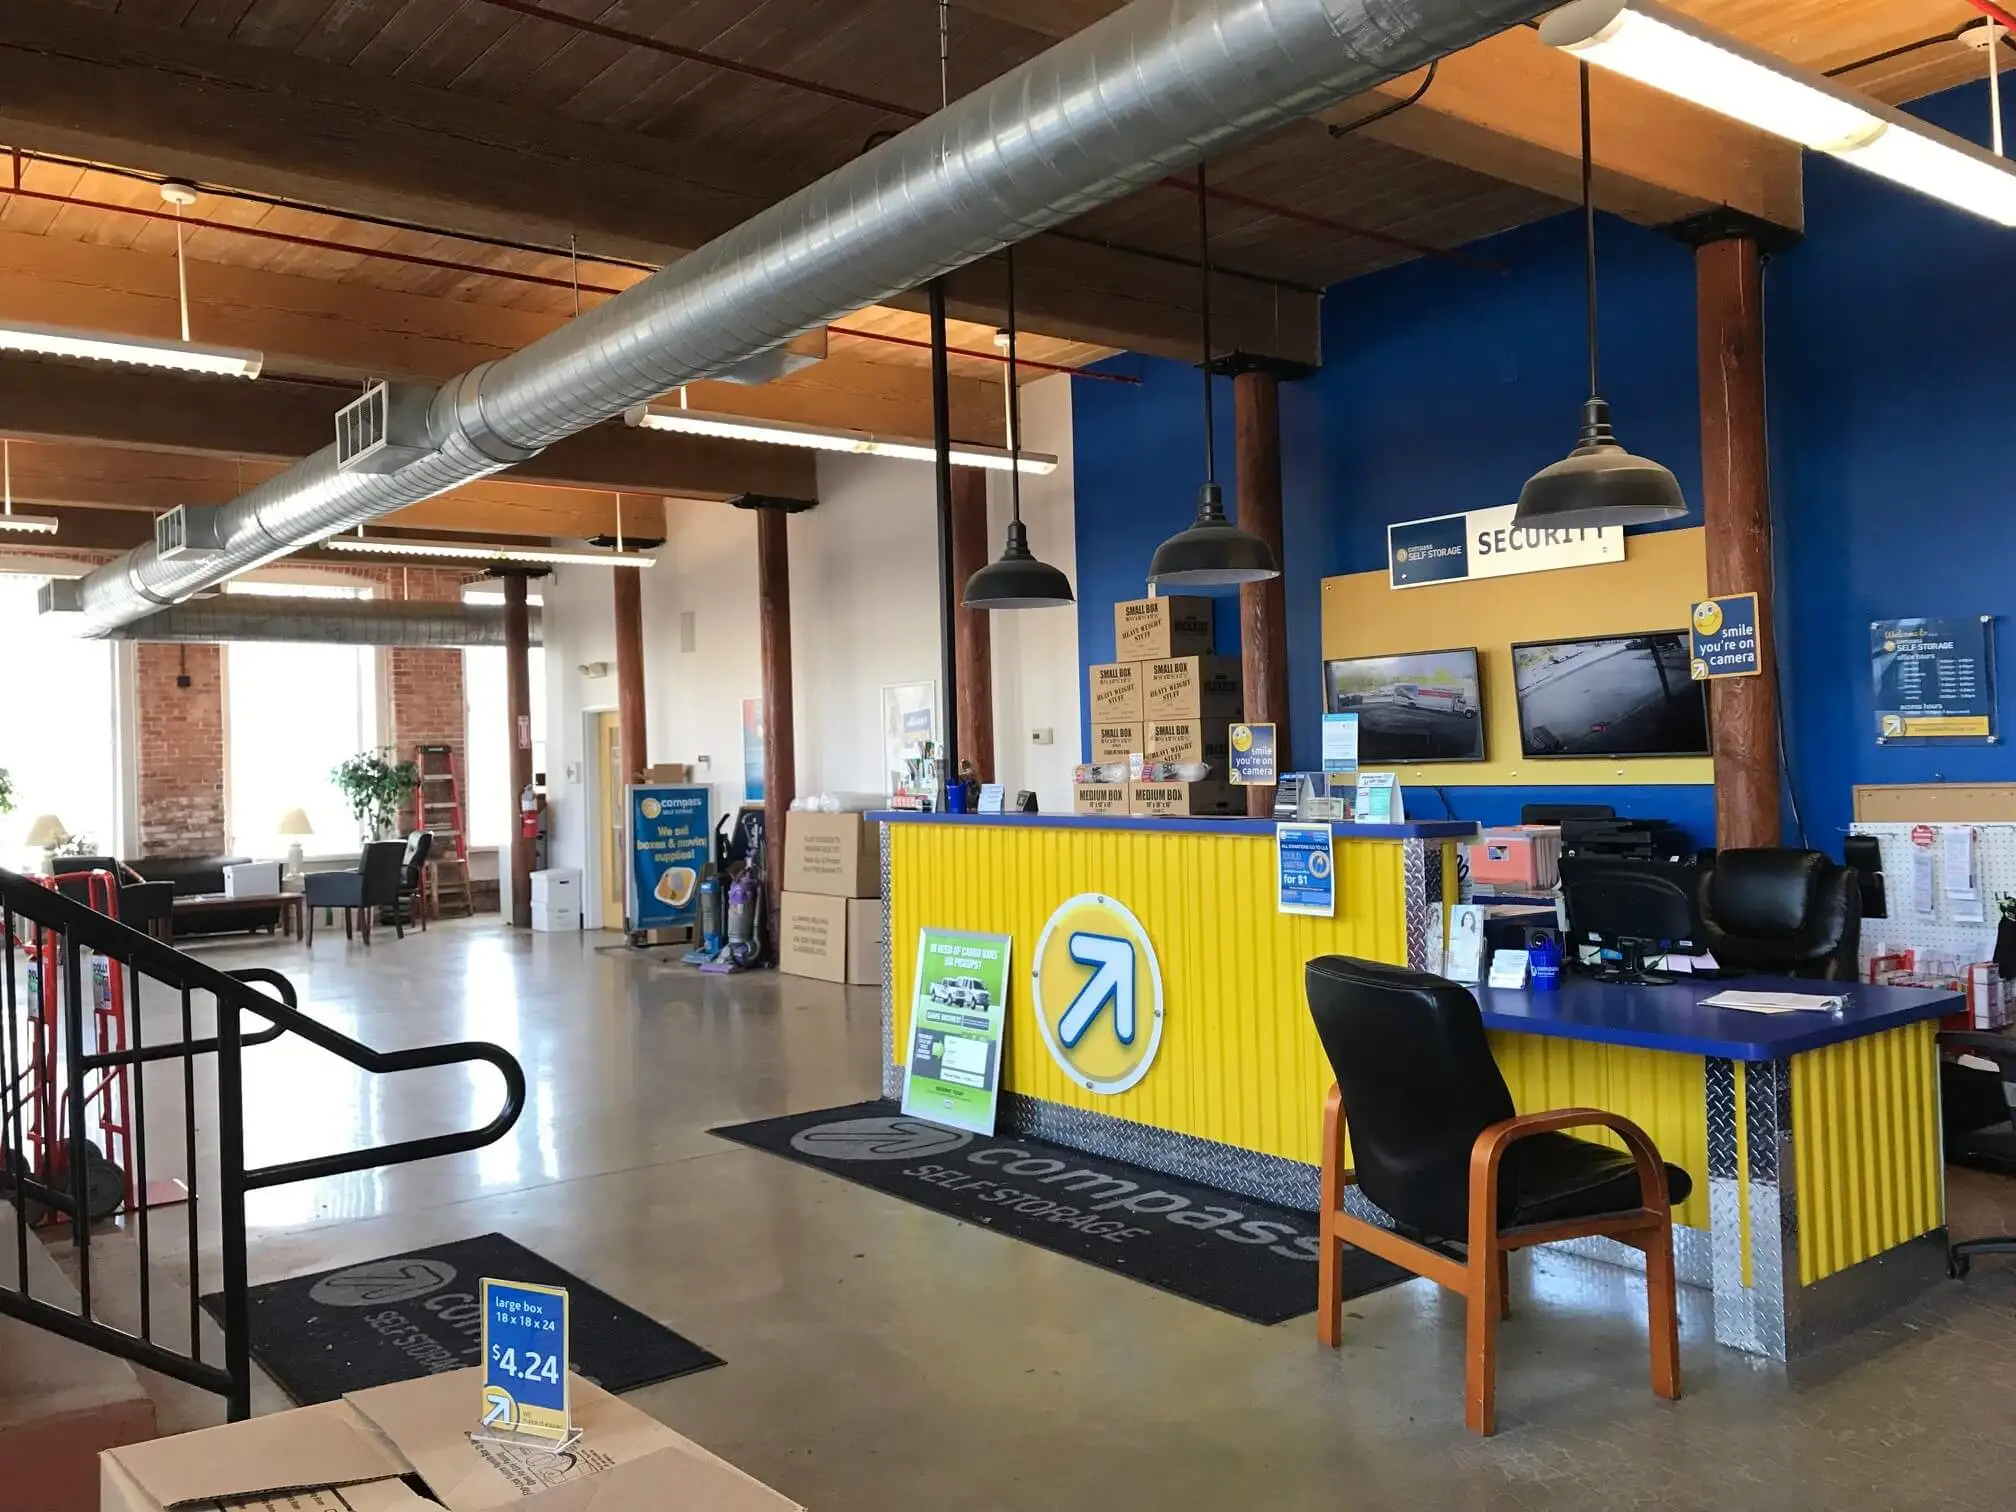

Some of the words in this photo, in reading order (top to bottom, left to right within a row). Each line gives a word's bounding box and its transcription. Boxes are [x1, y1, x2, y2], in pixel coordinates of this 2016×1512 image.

[1408, 551, 1427, 561] SELF
[1428, 546, 1462, 559] STORAGE
[1125, 604, 1145, 616] SMALL
[1146, 603, 1159, 614] BOX
[1122, 628, 1140, 640] HEAVY
[1140, 619, 1161, 632] WEIGHT
[1722, 624, 1753, 638] smile
[1700, 640, 1736, 656] you're
[1739, 639, 1754, 649] on
[1897, 644, 1916, 652] SELF
[1918, 642, 1954, 651] STORAGE
[1710, 652, 1754, 666] camera
[1100, 669, 1118, 679] SMALL
[1119, 668, 1131, 677] BOX
[1153, 664, 1174, 675] SMALL
[1175, 662, 1188, 673] BOX
[1169, 679, 1191, 691] WEIGHT
[1097, 691, 1113, 701] HEAVY
[1114, 684, 1134, 695] WEIGHT
[1162, 691, 1180, 701] STUFF
[1101, 729, 1119, 738] SMALL
[1120, 728, 1131, 737] BOX
[1155, 726, 1174, 736] SMALL
[1176, 725, 1189, 735] BOX
[1152, 749, 1169, 760] HEAVY
[1170, 742, 1192, 753] WEIGHT
[1251, 746, 1272, 755] smile
[1236, 756, 1261, 767] you're
[1080, 789, 1107, 801] MEDIUM
[1109, 789, 1122, 801] BOX
[1135, 789, 1165, 801] MEDIUM
[1167, 789, 1183, 801] BOX
[661, 798, 702, 808] compass
[657, 826, 673, 836] We
[668, 838, 676, 849] &
[1284, 874, 1296, 884] for
[1298, 874, 1308, 885] $1
[903, 1165, 998, 1191] SELF
[978, 1189, 1153, 1243] STORAGE
[967, 1149, 1356, 1261] compass
[495, 1296, 522, 1312] large
[523, 1301, 543, 1314] box
[496, 1312, 508, 1323] 18
[511, 1317, 517, 1325] x
[520, 1316, 532, 1327] 18
[534, 1321, 540, 1329] x
[542, 1320, 555, 1331] 24
[492, 1344, 559, 1384] $4.24
